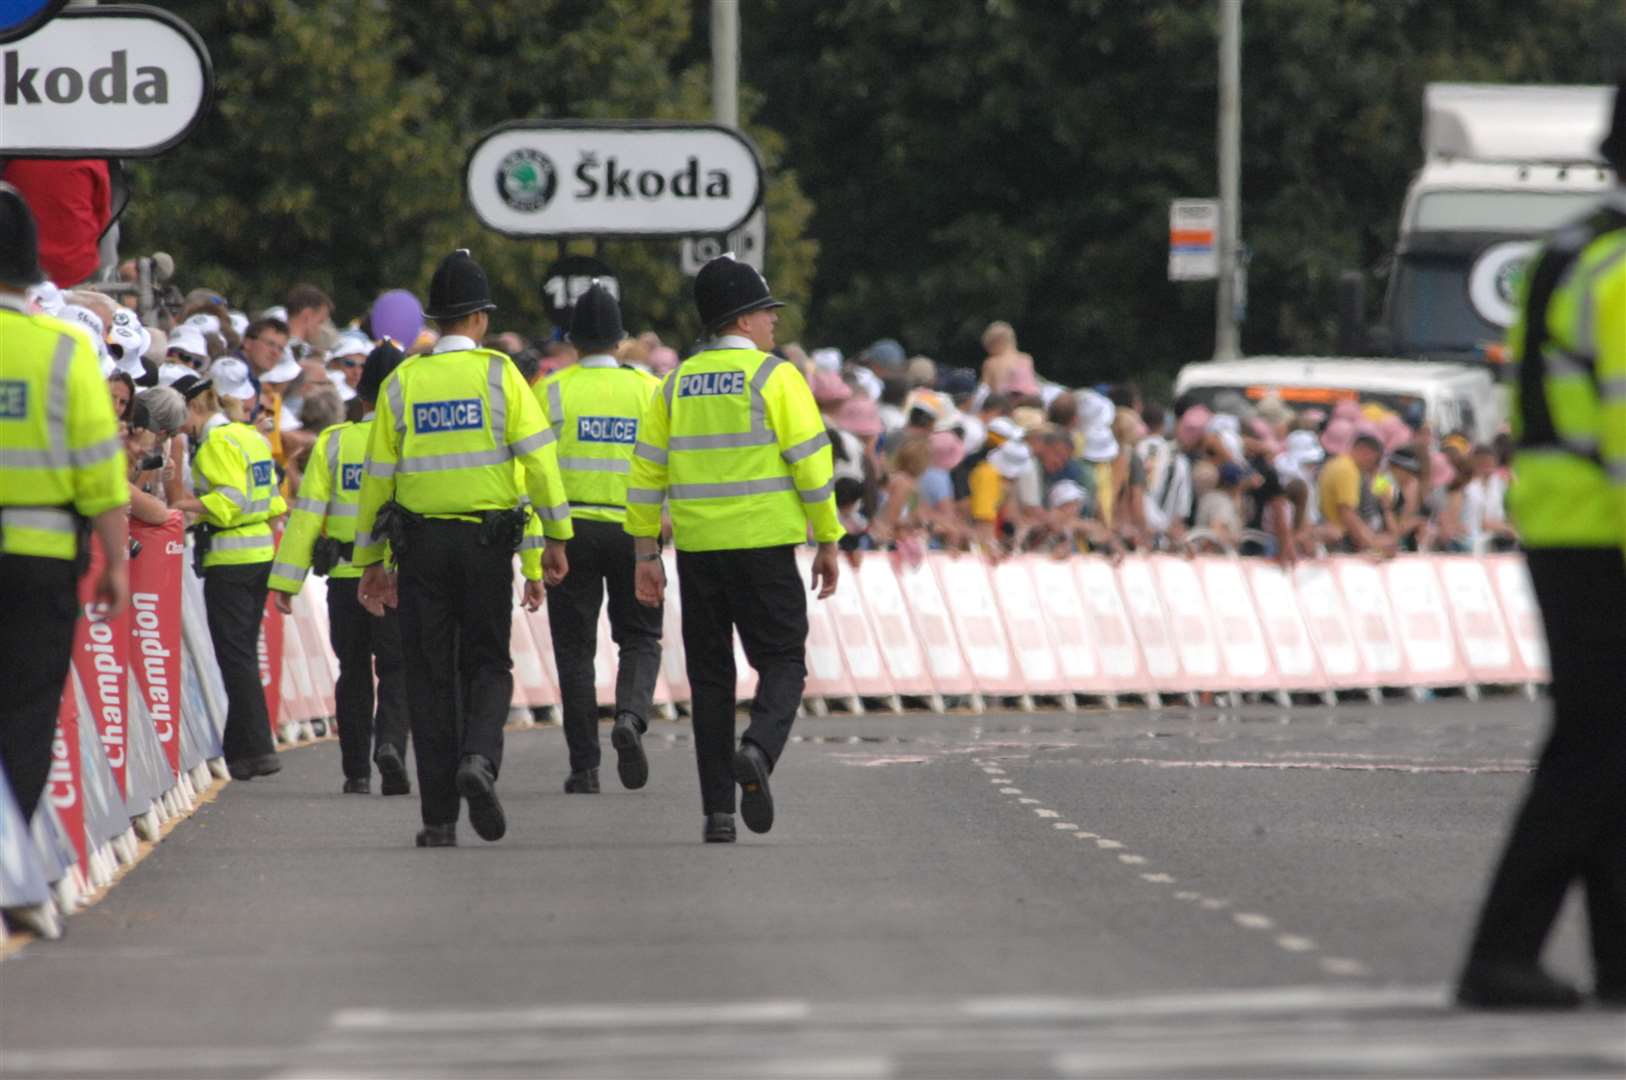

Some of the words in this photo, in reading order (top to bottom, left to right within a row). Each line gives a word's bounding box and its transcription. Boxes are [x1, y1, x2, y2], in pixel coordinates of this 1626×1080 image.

[574, 150, 730, 200] Škoda
[679, 372, 744, 396] POLICE
[415, 403, 480, 430] POLICE
[580, 419, 635, 441] POLICE
[131, 592, 174, 743] Champion
